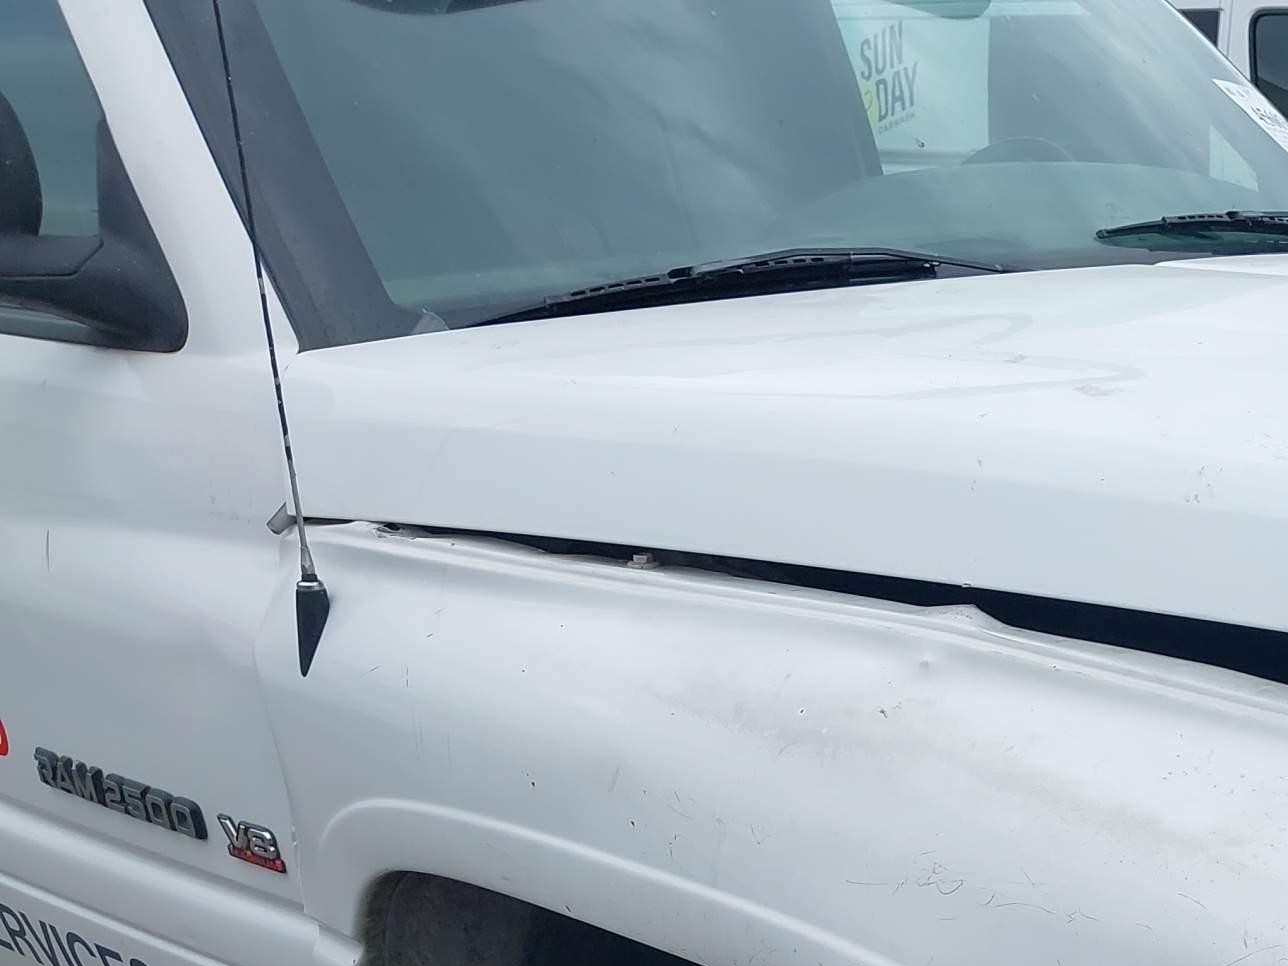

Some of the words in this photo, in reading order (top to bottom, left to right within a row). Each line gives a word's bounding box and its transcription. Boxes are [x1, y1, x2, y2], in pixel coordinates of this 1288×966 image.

[860, 20, 903, 82] SUN
[876, 61, 918, 122] DAY
[34, 746, 105, 805] RAM
[103, 773, 208, 840] 2500
[217, 813, 280, 860] V8
